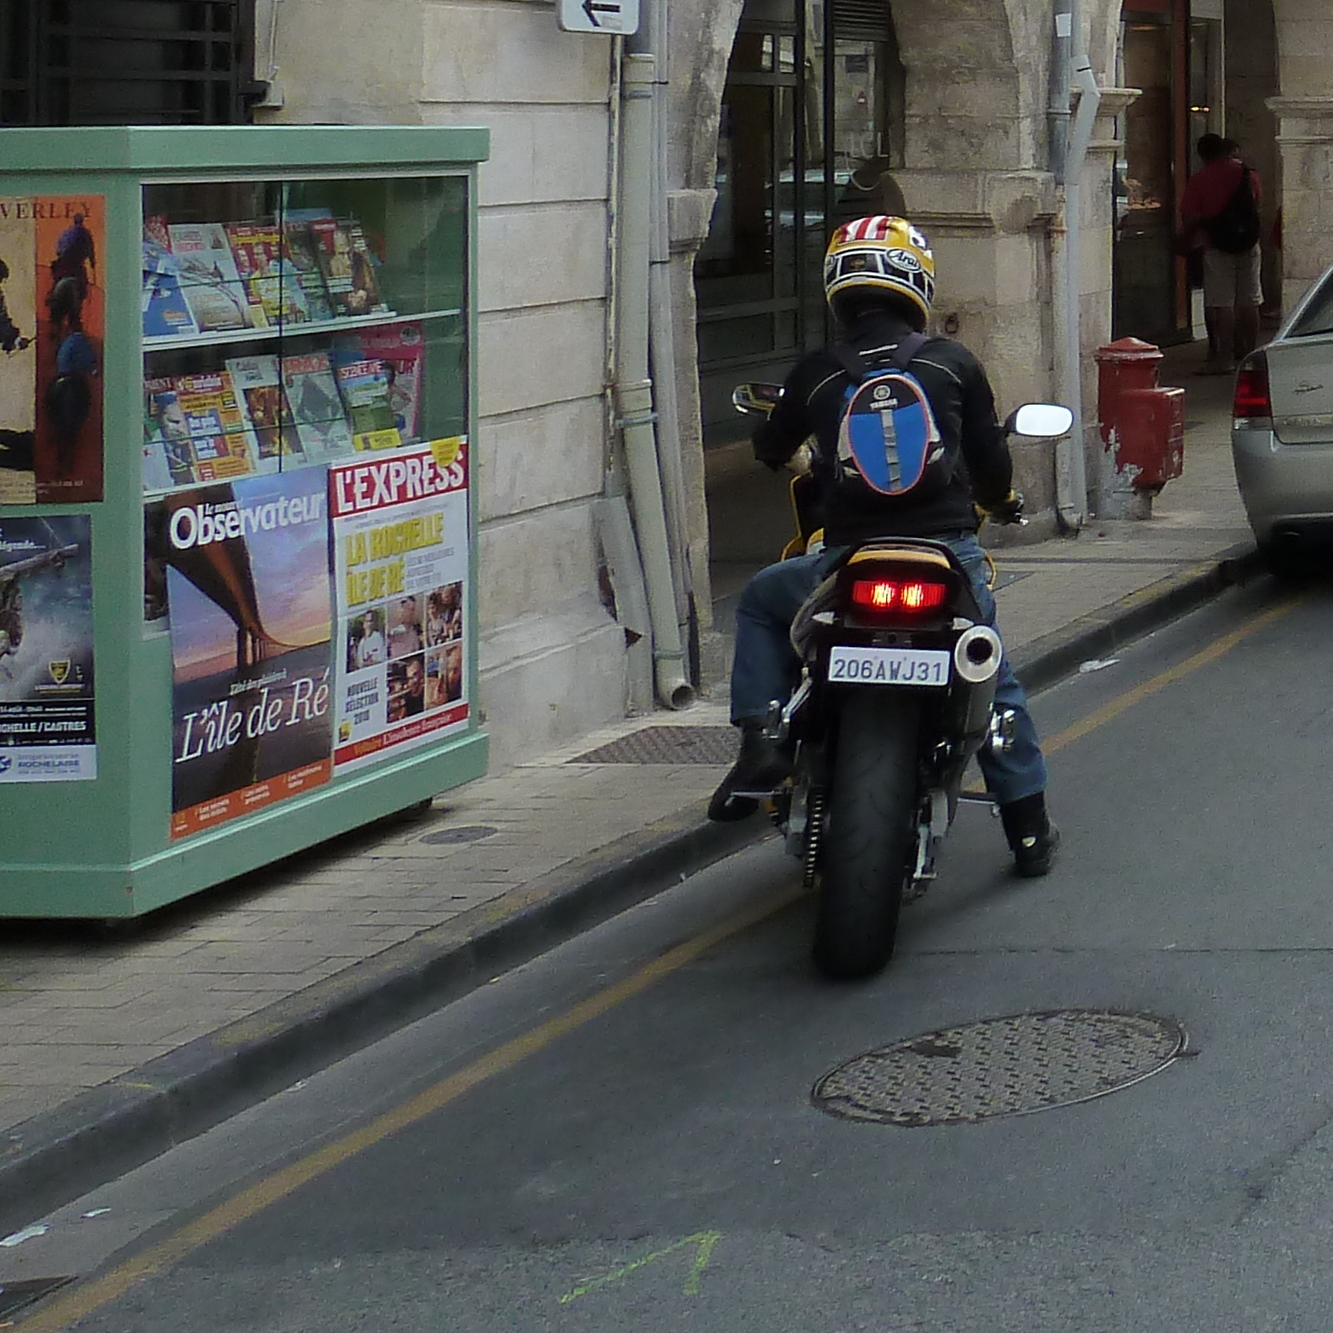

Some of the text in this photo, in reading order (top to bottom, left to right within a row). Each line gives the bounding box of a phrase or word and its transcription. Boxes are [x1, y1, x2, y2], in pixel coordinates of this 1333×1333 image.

[890, 250, 918, 268] Arai
[869, 398, 898, 410] YAMAHA
[335, 449, 464, 514] L'EXPRESS
[170, 491, 326, 550] Observateur
[345, 532, 366, 567] LA
[369, 513, 444, 562] ROCHELLE
[368, 566, 386, 602] DE
[175, 667, 330, 763] L'île de Ré
